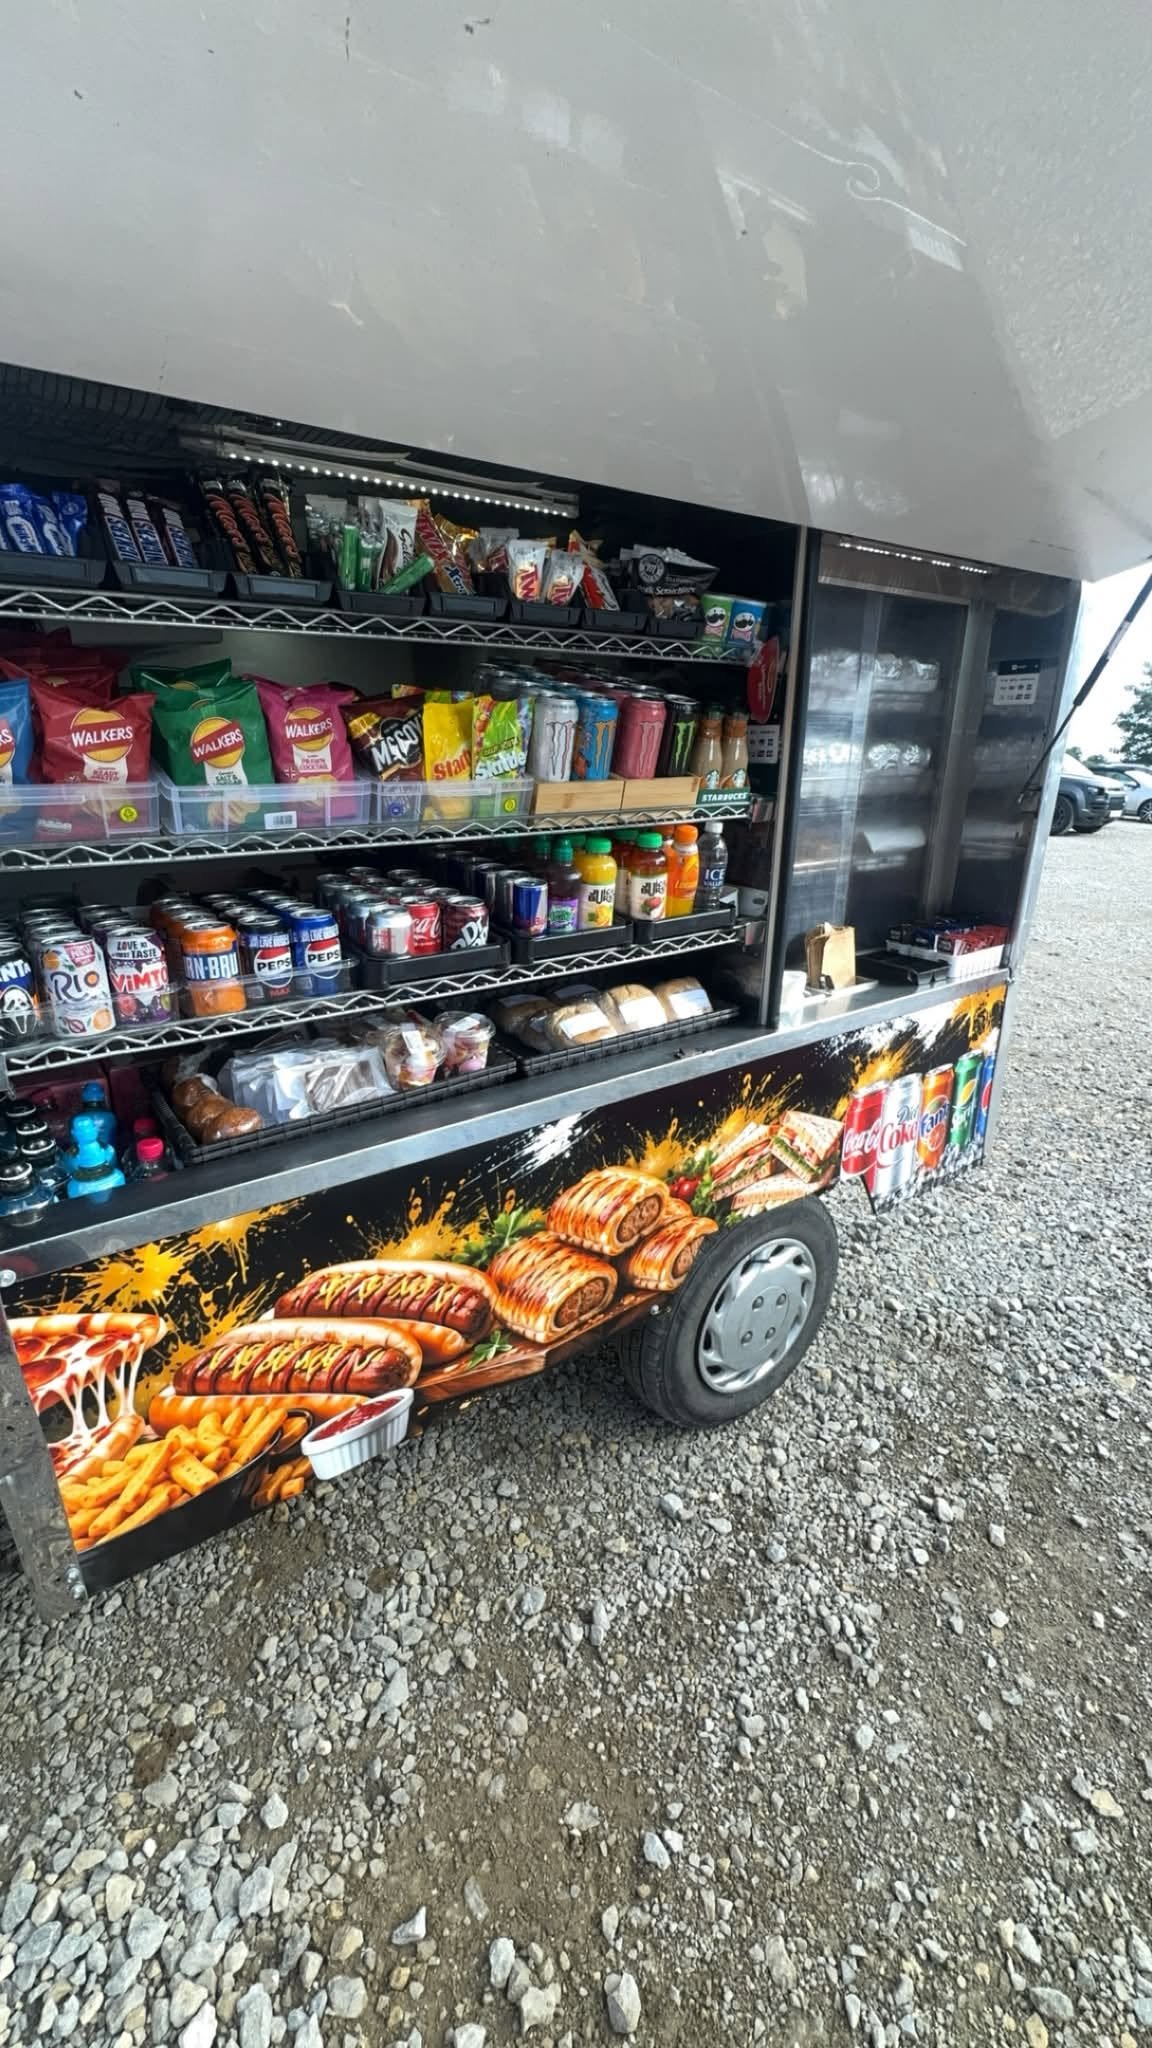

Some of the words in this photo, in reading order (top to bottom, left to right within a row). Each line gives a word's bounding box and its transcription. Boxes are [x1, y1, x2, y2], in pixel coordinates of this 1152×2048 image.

[285, 717, 333, 739] WALKERS
[71, 726, 133, 747] WALKERS
[193, 728, 243, 758] WALKERS
[475, 750, 528, 780] Skittle
[702, 792, 748, 802] STARBUCKS
[705, 867, 726, 880] ICE
[117, 940, 139, 951] LOVE
[131, 949, 158, 959] TASTE
[308, 949, 341, 964] PEPS
[257, 957, 291, 973] PEPS
[50, 970, 100, 1003] RIO
